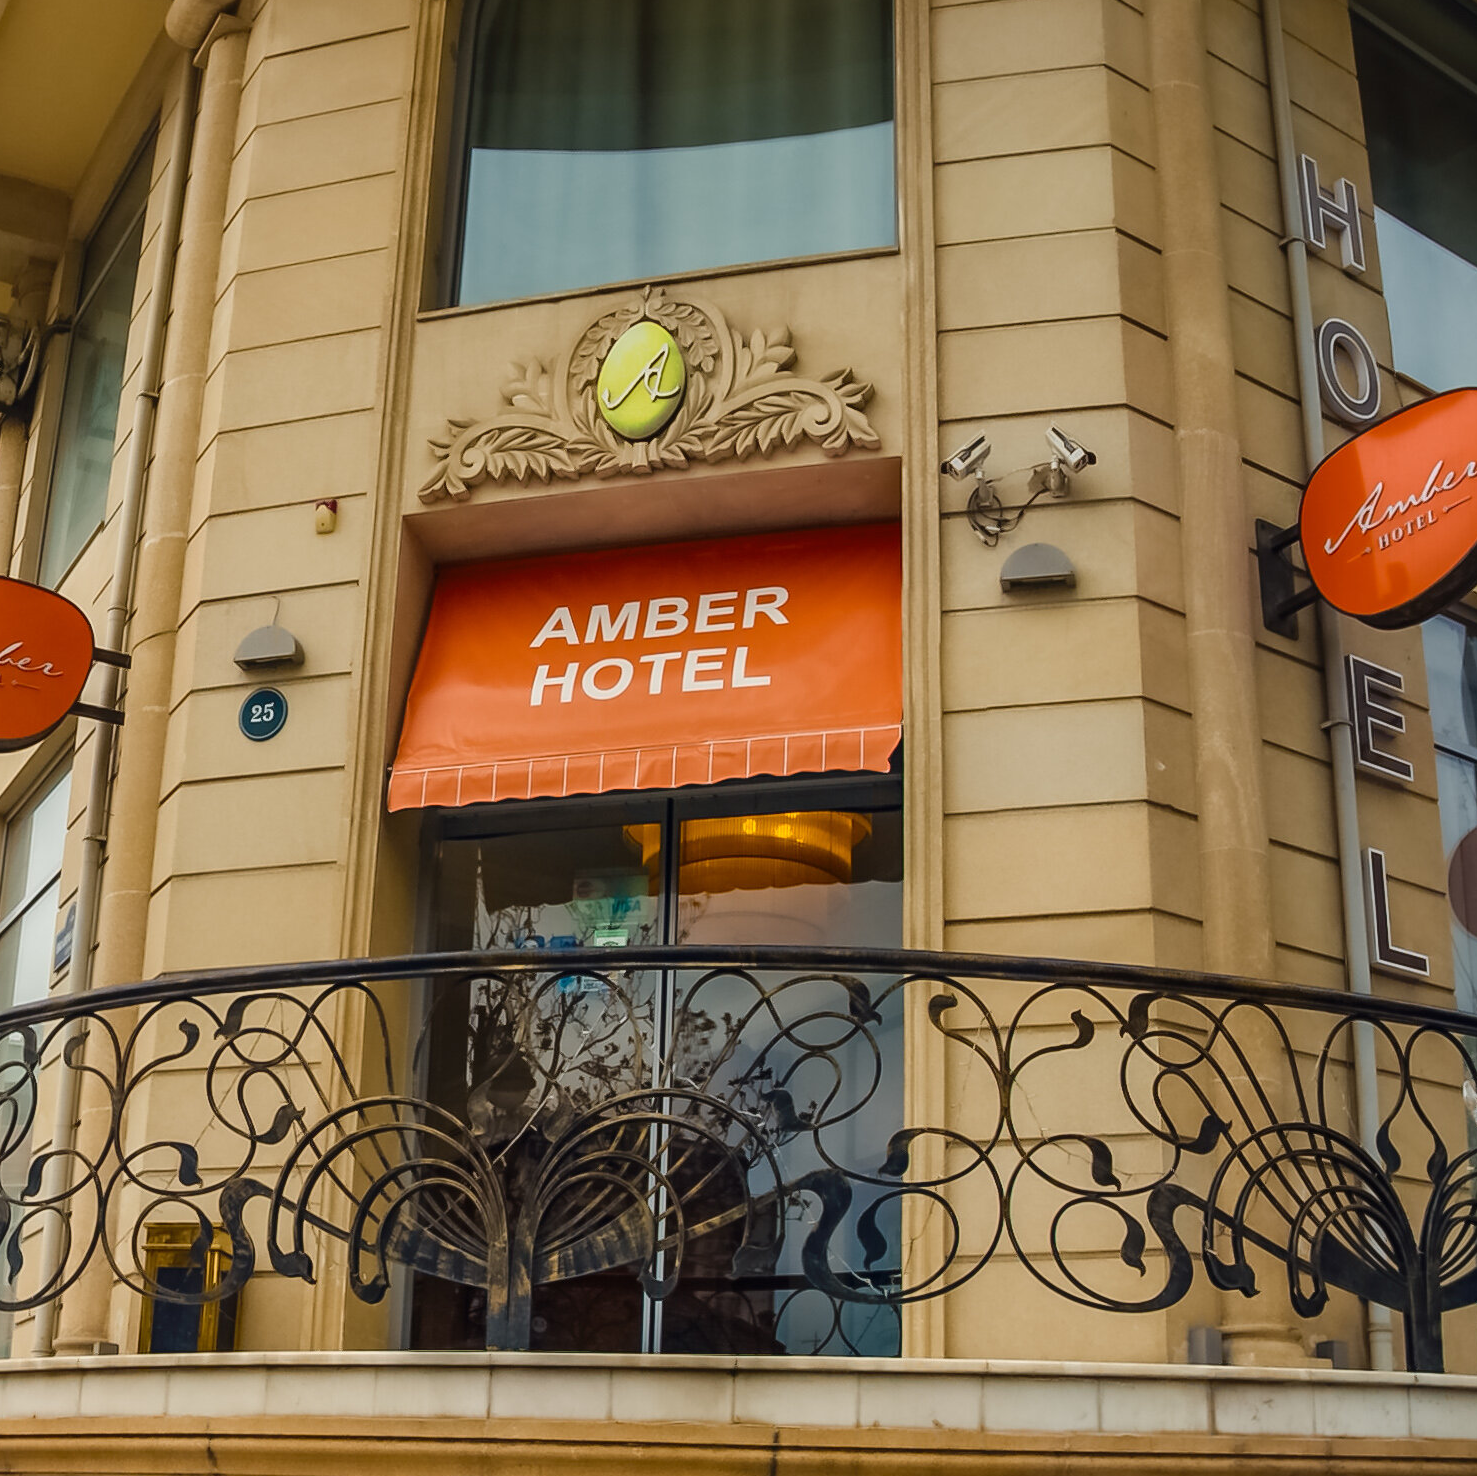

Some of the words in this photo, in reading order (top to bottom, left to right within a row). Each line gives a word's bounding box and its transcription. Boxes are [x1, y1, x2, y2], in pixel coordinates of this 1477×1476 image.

[1378, 509, 1438, 551] HOTEL
[1298, 152, 1431, 978] HOEL
[529, 586, 790, 649] AMBER
[530, 646, 772, 707] HOTEL
[251, 703, 275, 724] 25
